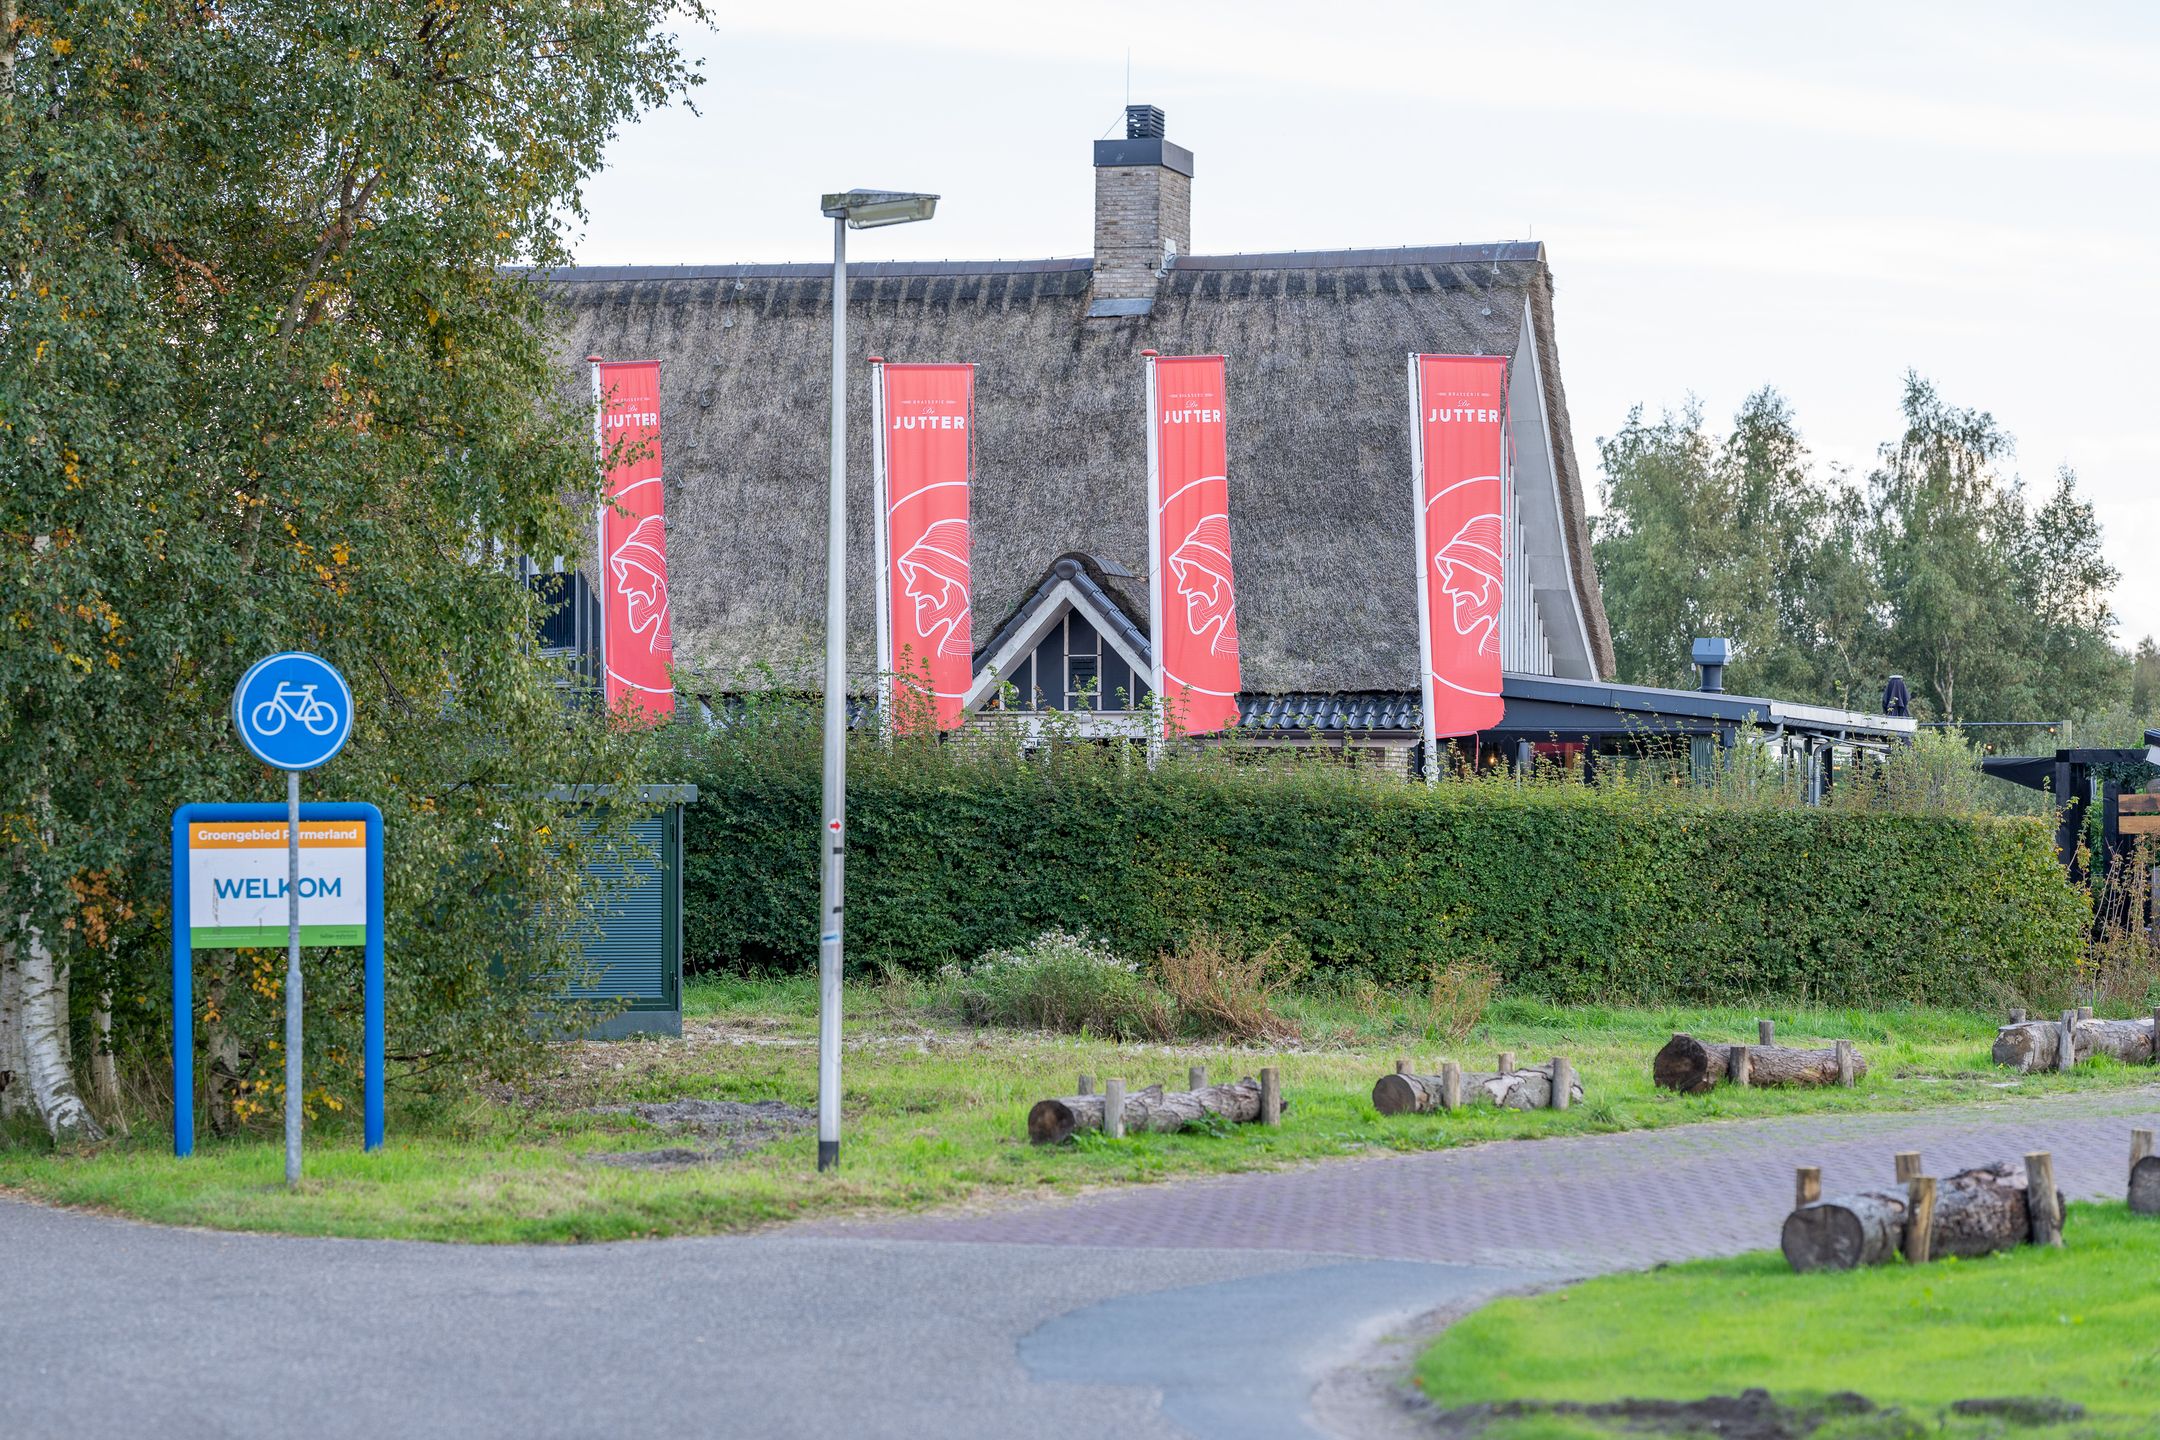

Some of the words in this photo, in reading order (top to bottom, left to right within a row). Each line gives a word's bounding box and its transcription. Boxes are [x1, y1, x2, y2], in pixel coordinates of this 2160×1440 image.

[606, 413, 657, 428] JUTTER
[893, 416, 965, 430] JUTTER
[1163, 409, 1221, 424] JUTTER
[1428, 408, 1499, 423] JUTTER
[198, 830, 280, 842] Groengebied
[282, 829, 357, 840] Prmerland
[214, 878, 342, 898] WELKOM
